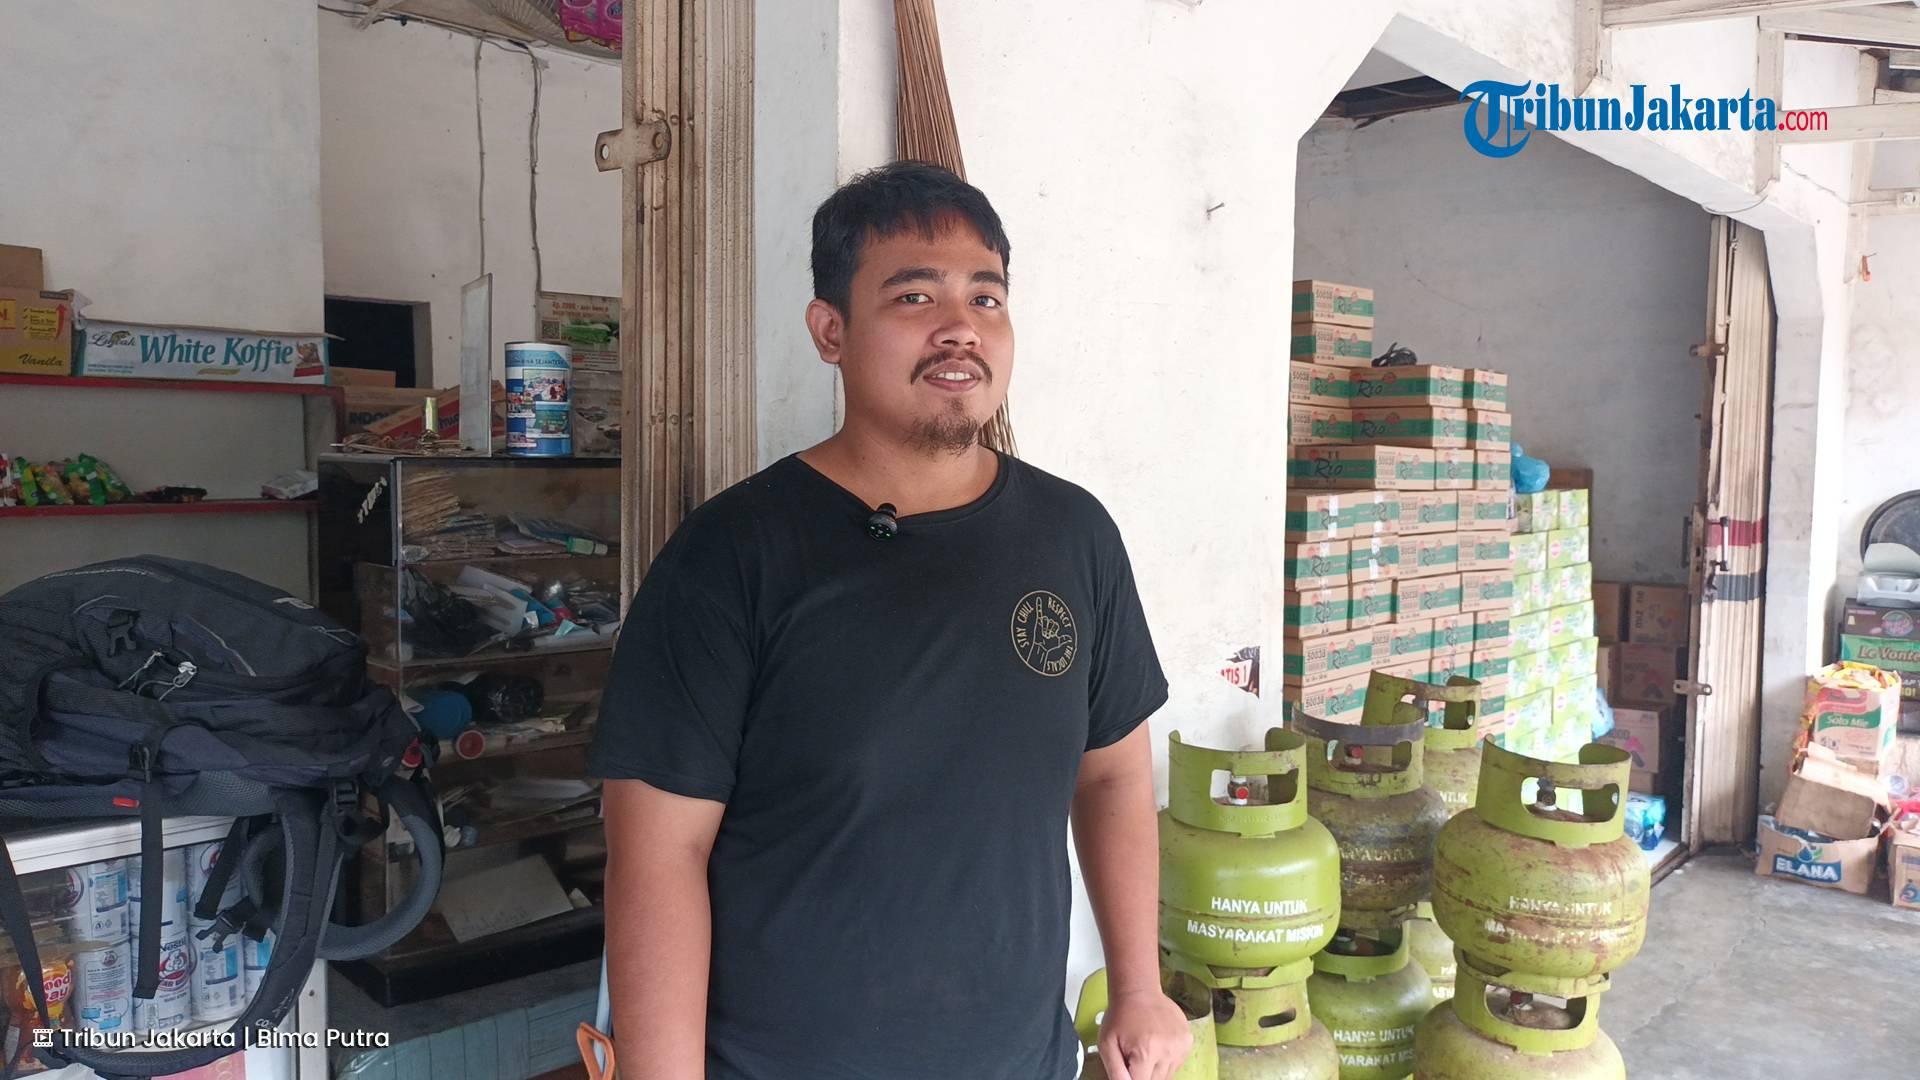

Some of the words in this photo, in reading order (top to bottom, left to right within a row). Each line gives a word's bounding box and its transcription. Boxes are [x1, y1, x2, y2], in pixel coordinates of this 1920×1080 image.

[140, 334, 216, 364] White
[222, 337, 293, 372] Koffie
[1359, 379, 1384, 398] Rio
[1362, 420, 1386, 438] Rio
[1314, 457, 1344, 479] Rio
[1311, 555, 1331, 577] Rio
[1017, 601, 1035, 624] CHILL
[1048, 596, 1072, 628] RESPECT
[1016, 627, 1030, 648] STAY
[1776, 857, 1839, 881] ELANA
[1211, 896, 1260, 914] HANYA
[1263, 899, 1308, 915] UNTUK
[1187, 919, 1284, 943] MASYARAKAT
[1286, 923, 1324, 943] MISKIN
[44, 969, 71, 991] ood
[1333, 1030, 1376, 1043] HANYA
[1380, 1024, 1415, 1042] UNTUK
[1340, 1051, 1396, 1067] YARAKAT
